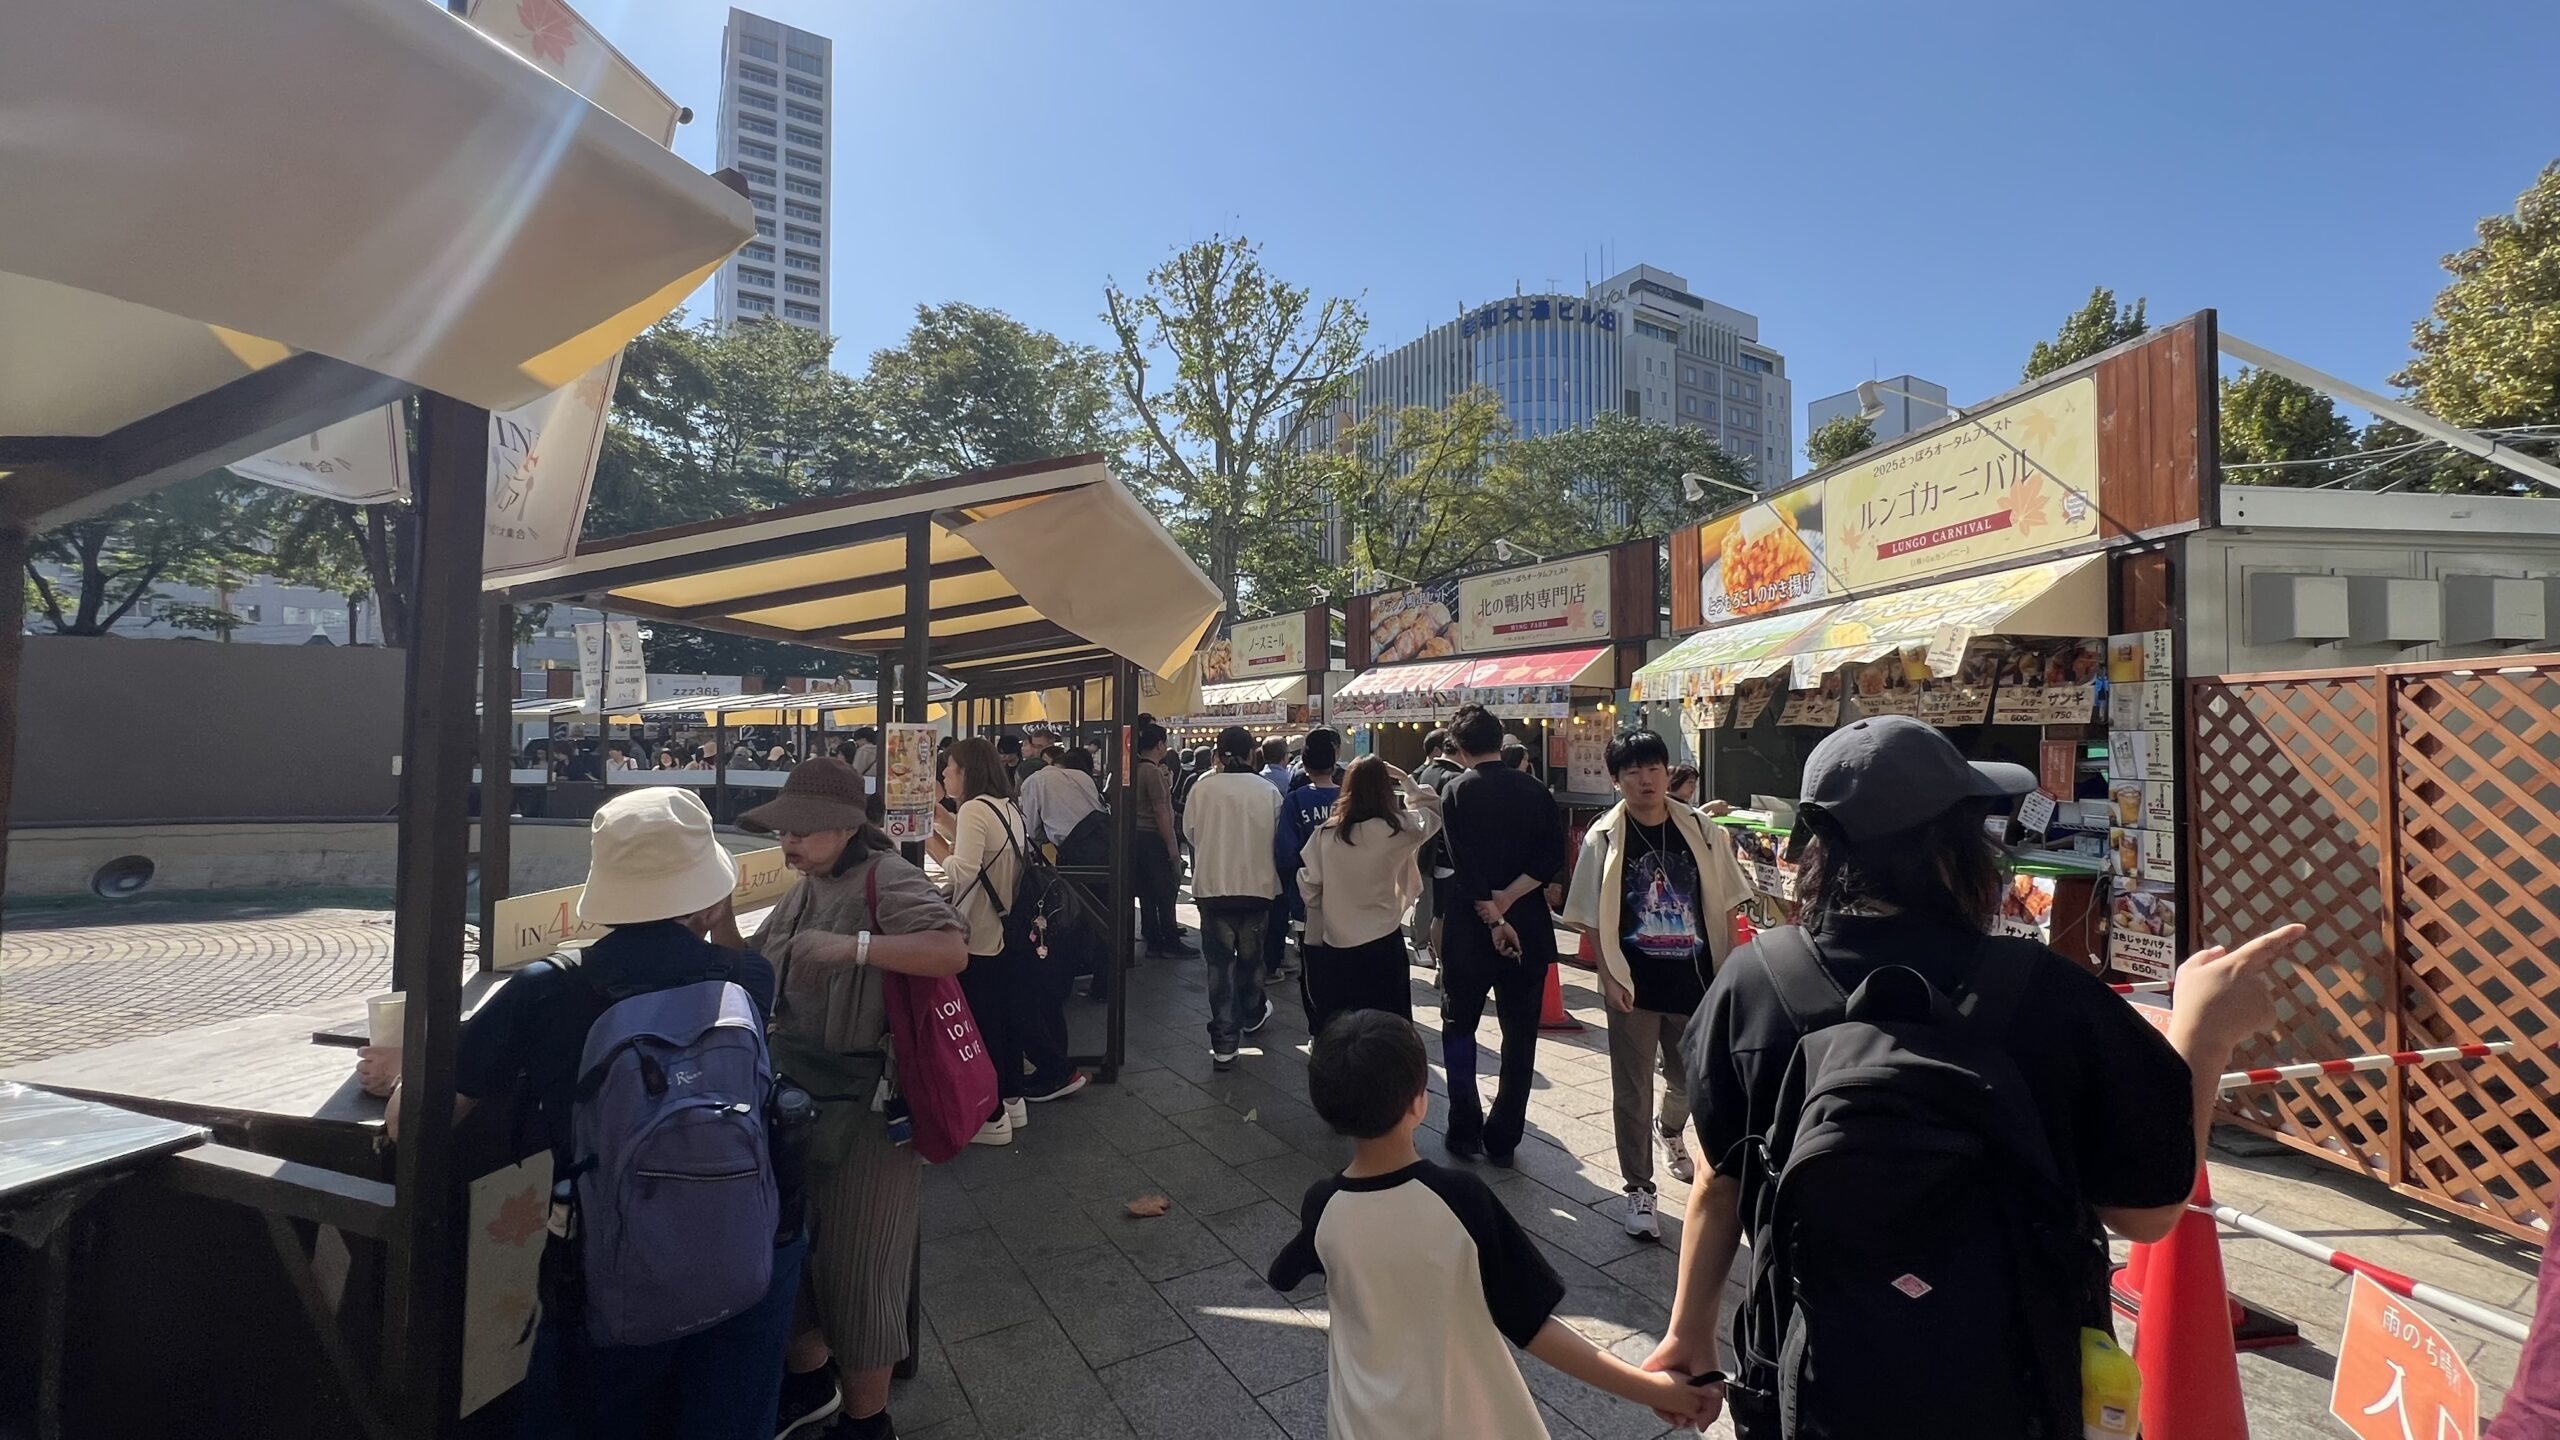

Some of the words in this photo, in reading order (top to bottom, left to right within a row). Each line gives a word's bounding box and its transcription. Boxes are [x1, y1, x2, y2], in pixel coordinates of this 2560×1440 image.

[1873, 417, 2012, 478] 2025さっぽろオータムフェスト
[1860, 448, 2035, 532] ルンゴカーニバル
[1891, 537, 1927, 555] LUNGO
[1932, 519, 1993, 544] CARNIVAL
[1478, 583, 1587, 617] 北の鴨肉専門店
[1708, 571, 1816, 615] とうもろこしのかき揚げ
[1249, 633, 1286, 652] ノースミール
[673, 687, 720, 697] zzz365
[2047, 690, 2086, 706] ザンギ
[2113, 932, 2173, 949] 3色じゃがバター
[2124, 945, 2162, 959] チーズがけ
[2131, 963, 2157, 976] 650円
[935, 998, 961, 1020] LOV
